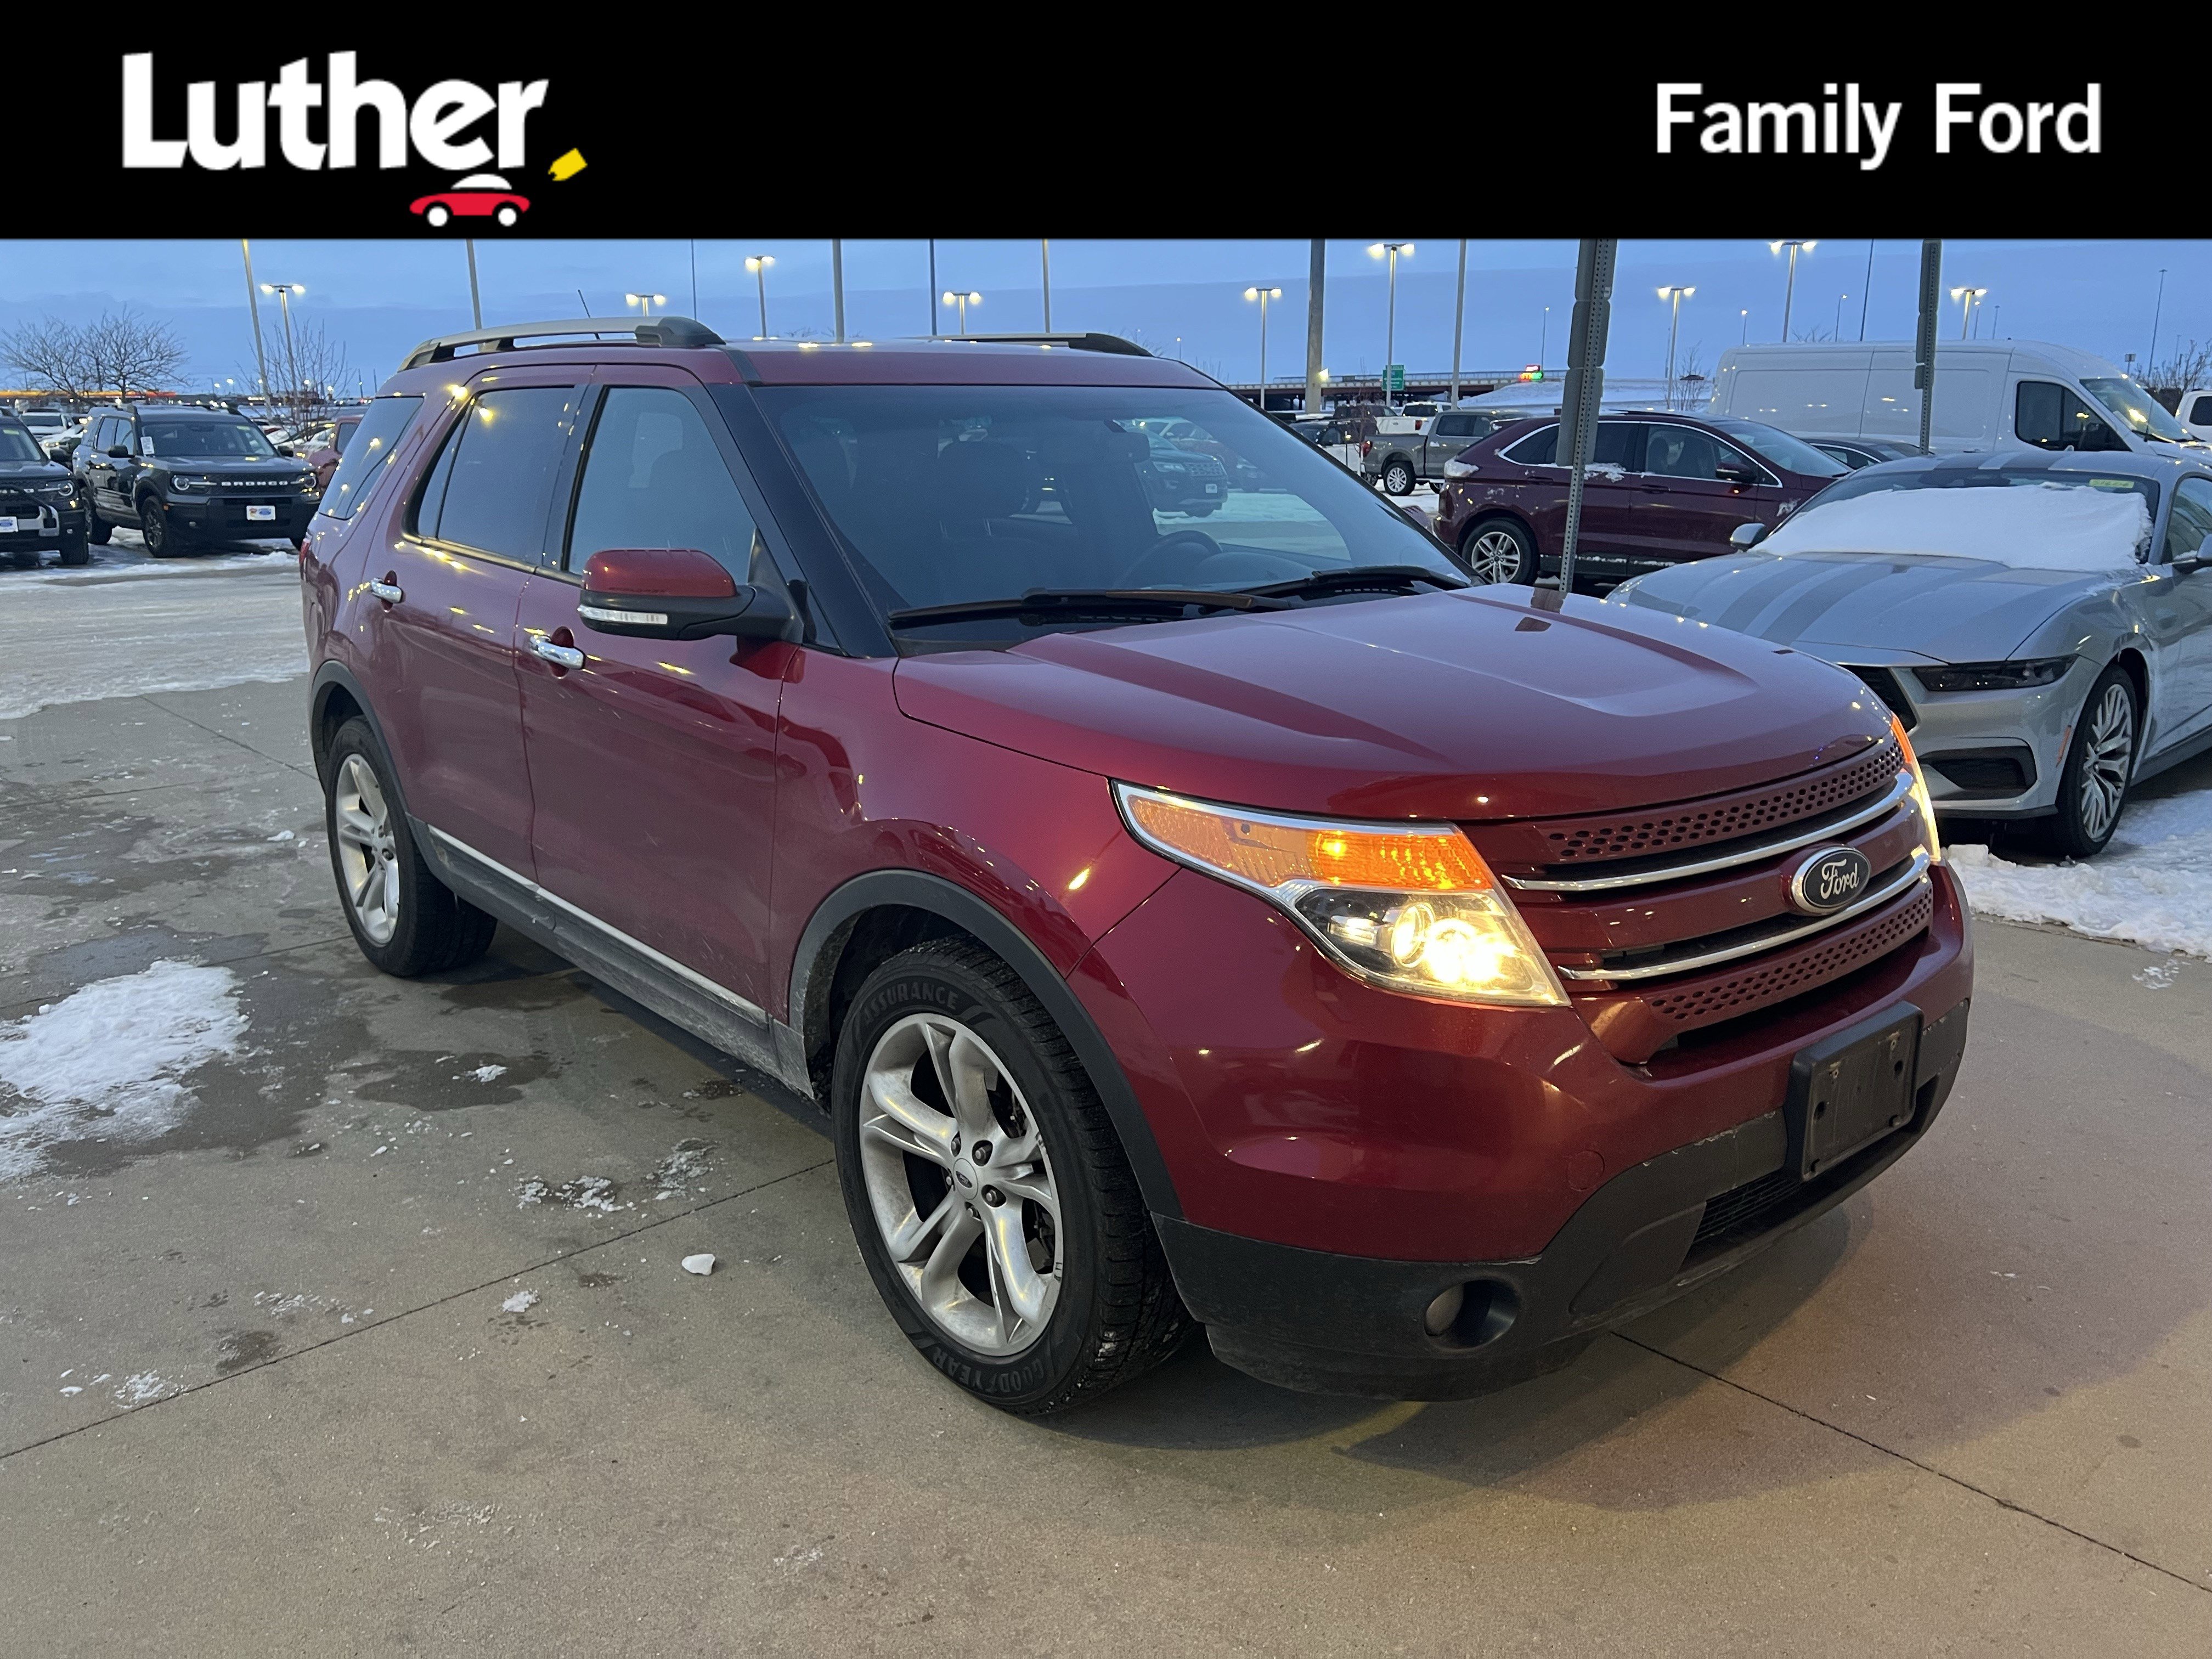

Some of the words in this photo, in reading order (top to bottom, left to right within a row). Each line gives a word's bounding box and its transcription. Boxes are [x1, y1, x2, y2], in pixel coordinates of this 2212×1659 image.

[1821, 859, 1860, 899] Ford
[864, 982, 958, 1024] ASSURANCE
[933, 1347, 1043, 1392] GOODYEAR
